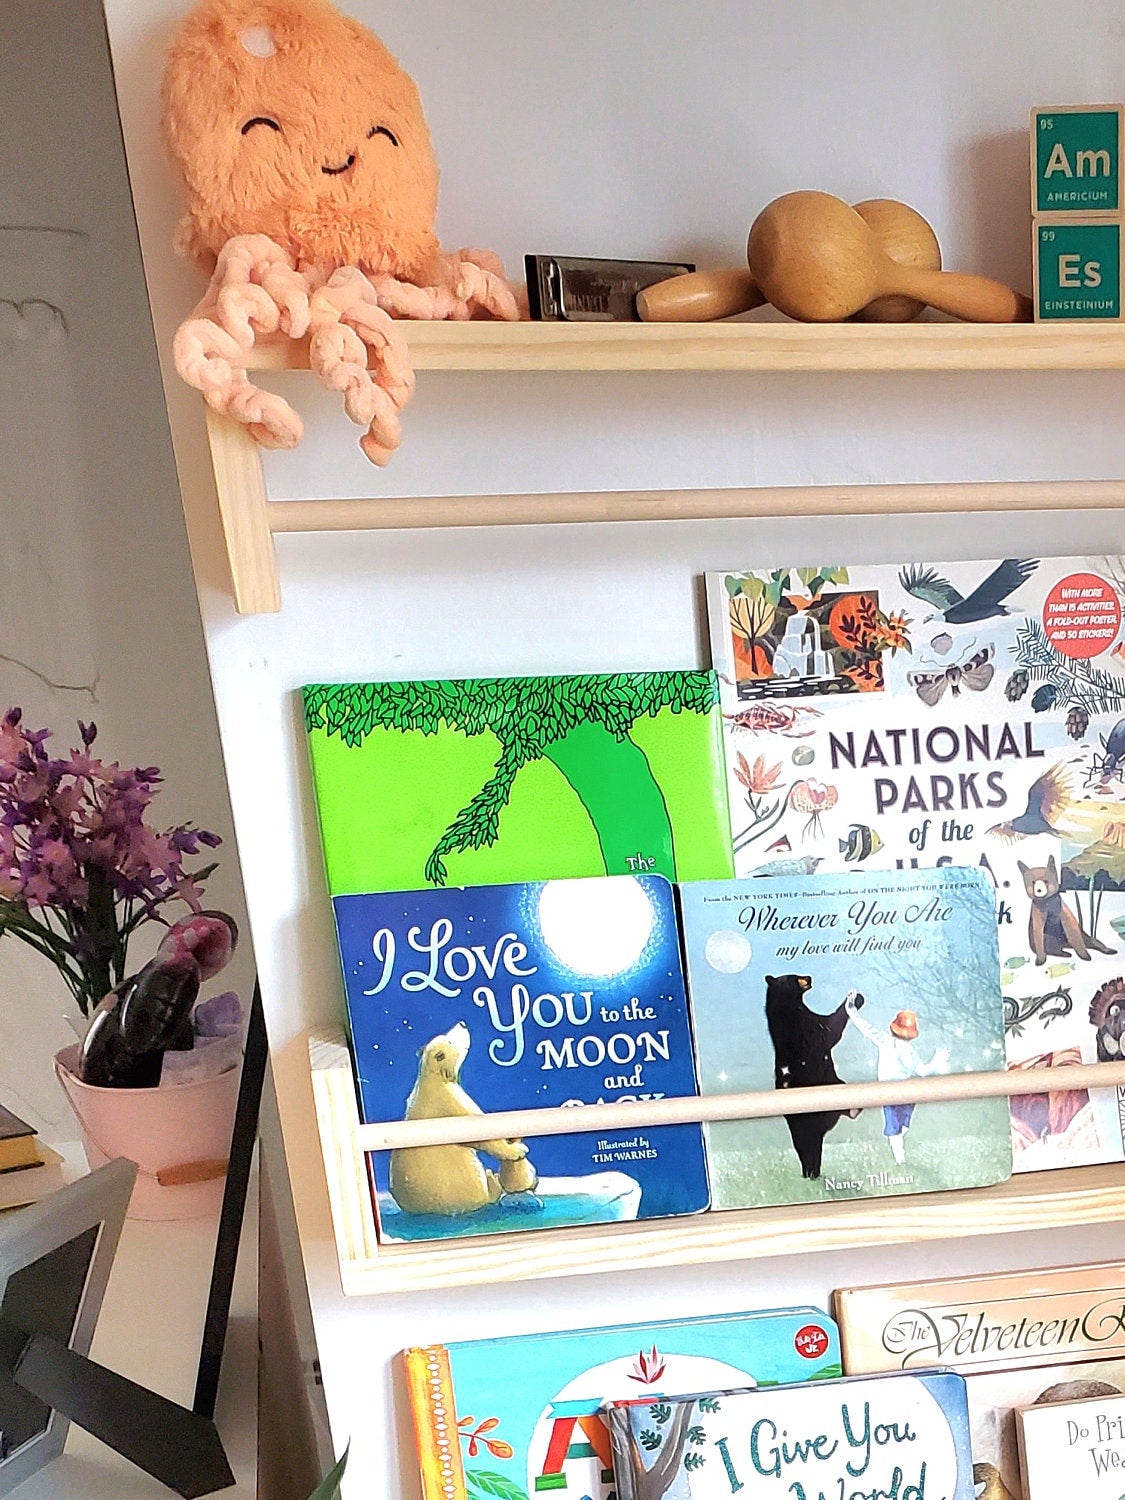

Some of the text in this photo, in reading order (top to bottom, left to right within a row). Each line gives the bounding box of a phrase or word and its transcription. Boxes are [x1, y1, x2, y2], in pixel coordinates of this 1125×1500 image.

[1044, 143, 1111, 179] Am
[1047, 191, 1108, 202] AMERICIUM
[1041, 231, 1055, 242] 99
[1058, 254, 1101, 288] Es
[1045, 299, 1114, 310] EINSTEINIUM
[1061, 587, 1103, 599] WITH MORE
[1048, 603, 1068, 612] THAN
[1054, 615, 1089, 626] FOLD-OUT
[1051, 629, 1114, 640] AND STICKERS!
[828, 721, 1046, 770] NATIONAL
[874, 771, 1008, 816] PARKS
[908, 820, 974, 851] of the
[626, 853, 656, 872] The
[738, 897, 953, 935] Wherever You Are
[363, 918, 538, 998] I Love
[776, 936, 922, 961] my love will find you
[599, 997, 657, 1024] to the
[536, 1030, 671, 1070] MOON
[604, 1065, 645, 1090] and
[592, 1149, 658, 1163] TIM WARNES
[598, 1136, 649, 1151] Illustrated by
[825, 1173, 914, 1191] Nancy Tillman
[902, 1310, 1080, 1370] Velveteen
[1067, 1420, 1089, 1446] Do
[714, 1401, 917, 1494] I Give You
